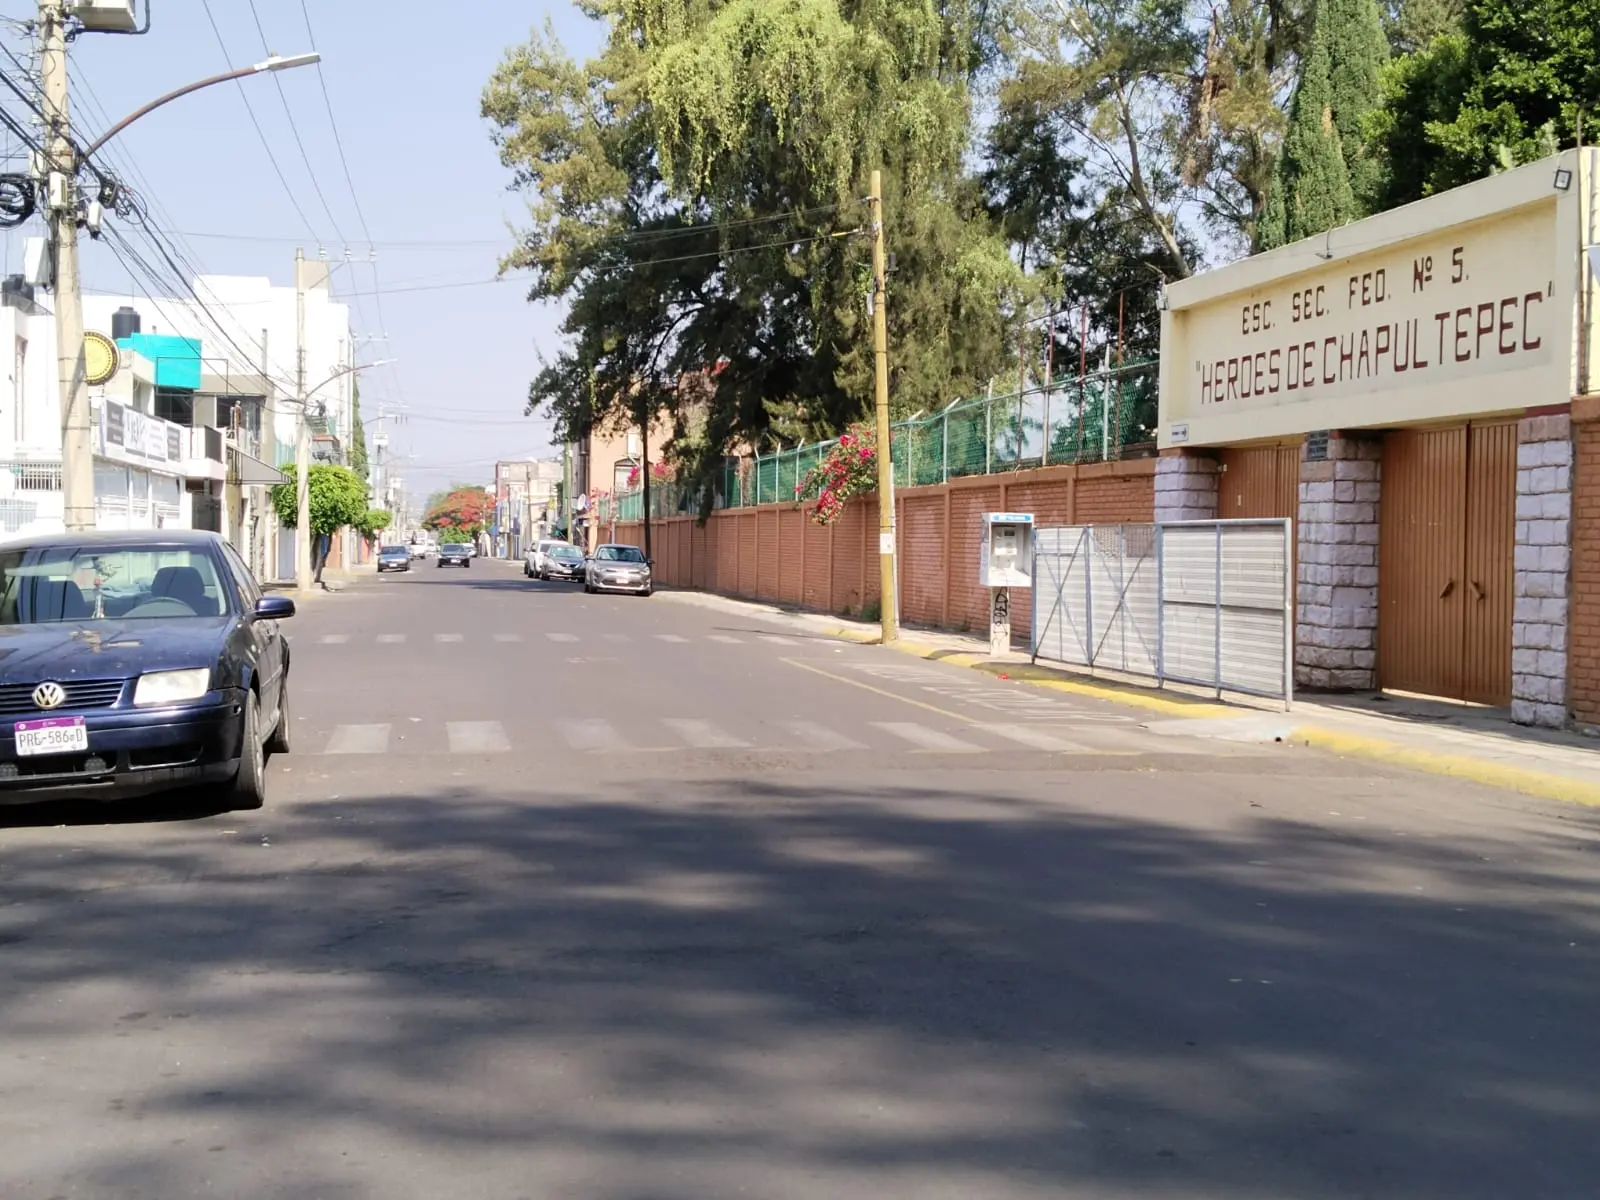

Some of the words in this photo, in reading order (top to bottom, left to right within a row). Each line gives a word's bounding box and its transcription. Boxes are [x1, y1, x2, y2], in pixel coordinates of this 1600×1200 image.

[1241, 300, 1276, 335] ESC.
[1291, 285, 1330, 322] SEC.
[1348, 268, 1392, 310] FED.
[1451, 246, 1470, 284] 5.
[1287, 341, 1316, 391] DE
